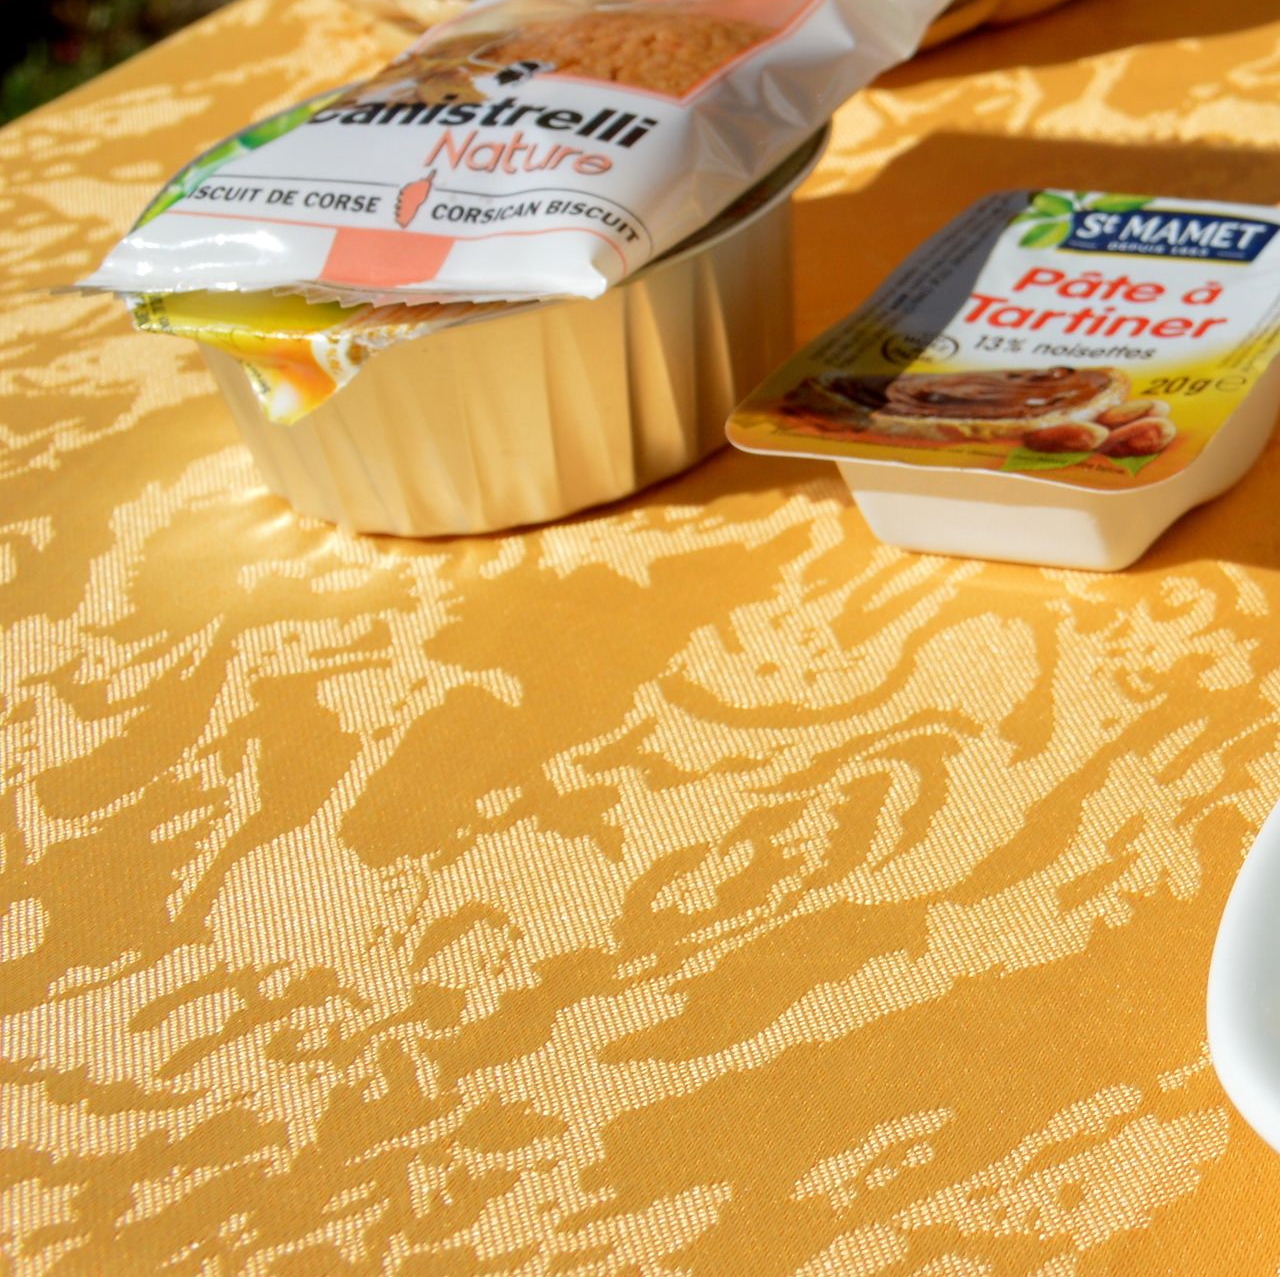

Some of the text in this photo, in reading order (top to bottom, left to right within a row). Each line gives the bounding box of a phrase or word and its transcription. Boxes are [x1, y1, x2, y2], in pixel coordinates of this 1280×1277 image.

[425, 130, 613, 176] Nature
[266, 189, 299, 206] DE
[304, 192, 382, 213] CORSE
[431, 199, 641, 245] CORSICAN BISCUIT
[1118, 214, 1268, 250] MAMET
[1012, 267, 1165, 306] Pâte
[962, 292, 1231, 339] Tartiner
[973, 335, 1026, 353] 13%
[1032, 341, 1157, 360] noisettes
